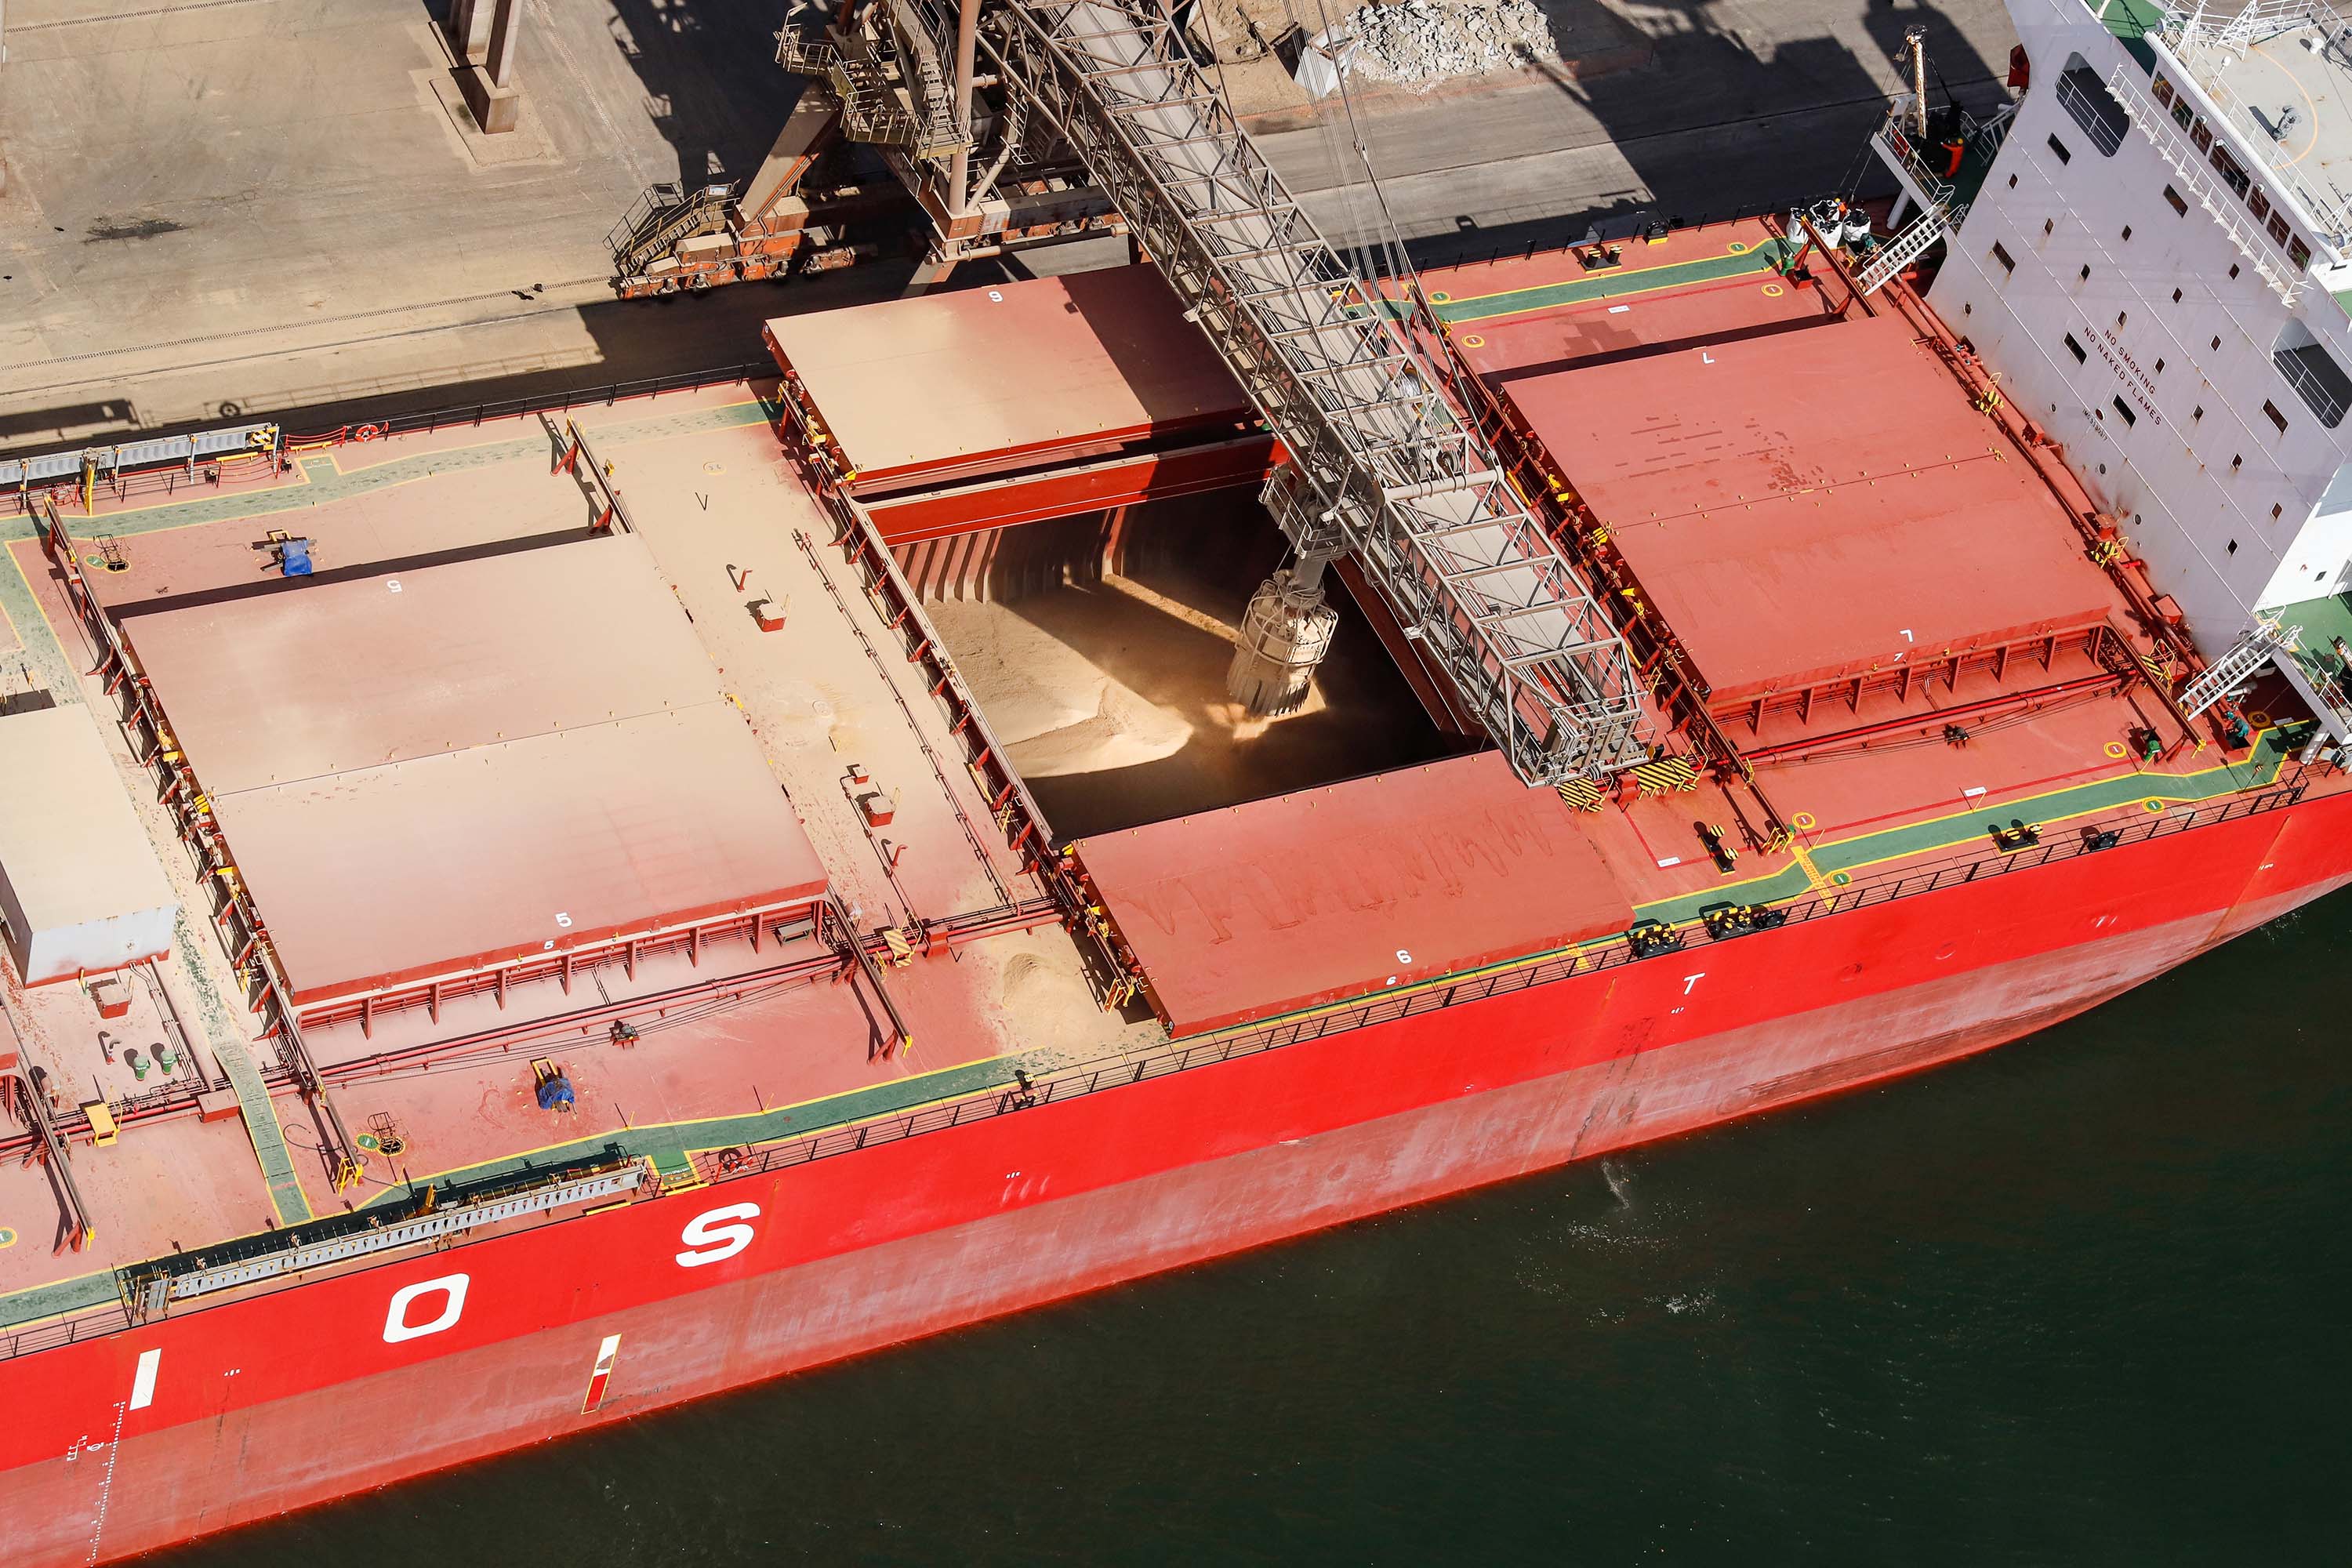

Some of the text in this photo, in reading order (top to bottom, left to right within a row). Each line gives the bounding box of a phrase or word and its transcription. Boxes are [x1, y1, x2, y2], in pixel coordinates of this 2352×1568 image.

[2104, 329, 2155, 394] NO SMOKING
[2084, 327, 2161, 425] NO NAKED FLAMES
[387, 579, 403, 593] 5
[1900, 629, 1913, 642] 7
[1893, 652, 1904, 662] 7
[555, 912, 572, 927] 5
[544, 940, 554, 950] 5
[1396, 949, 1412, 964] 6
[1386, 976, 1396, 985] 6
[1683, 972, 1705, 995] T
